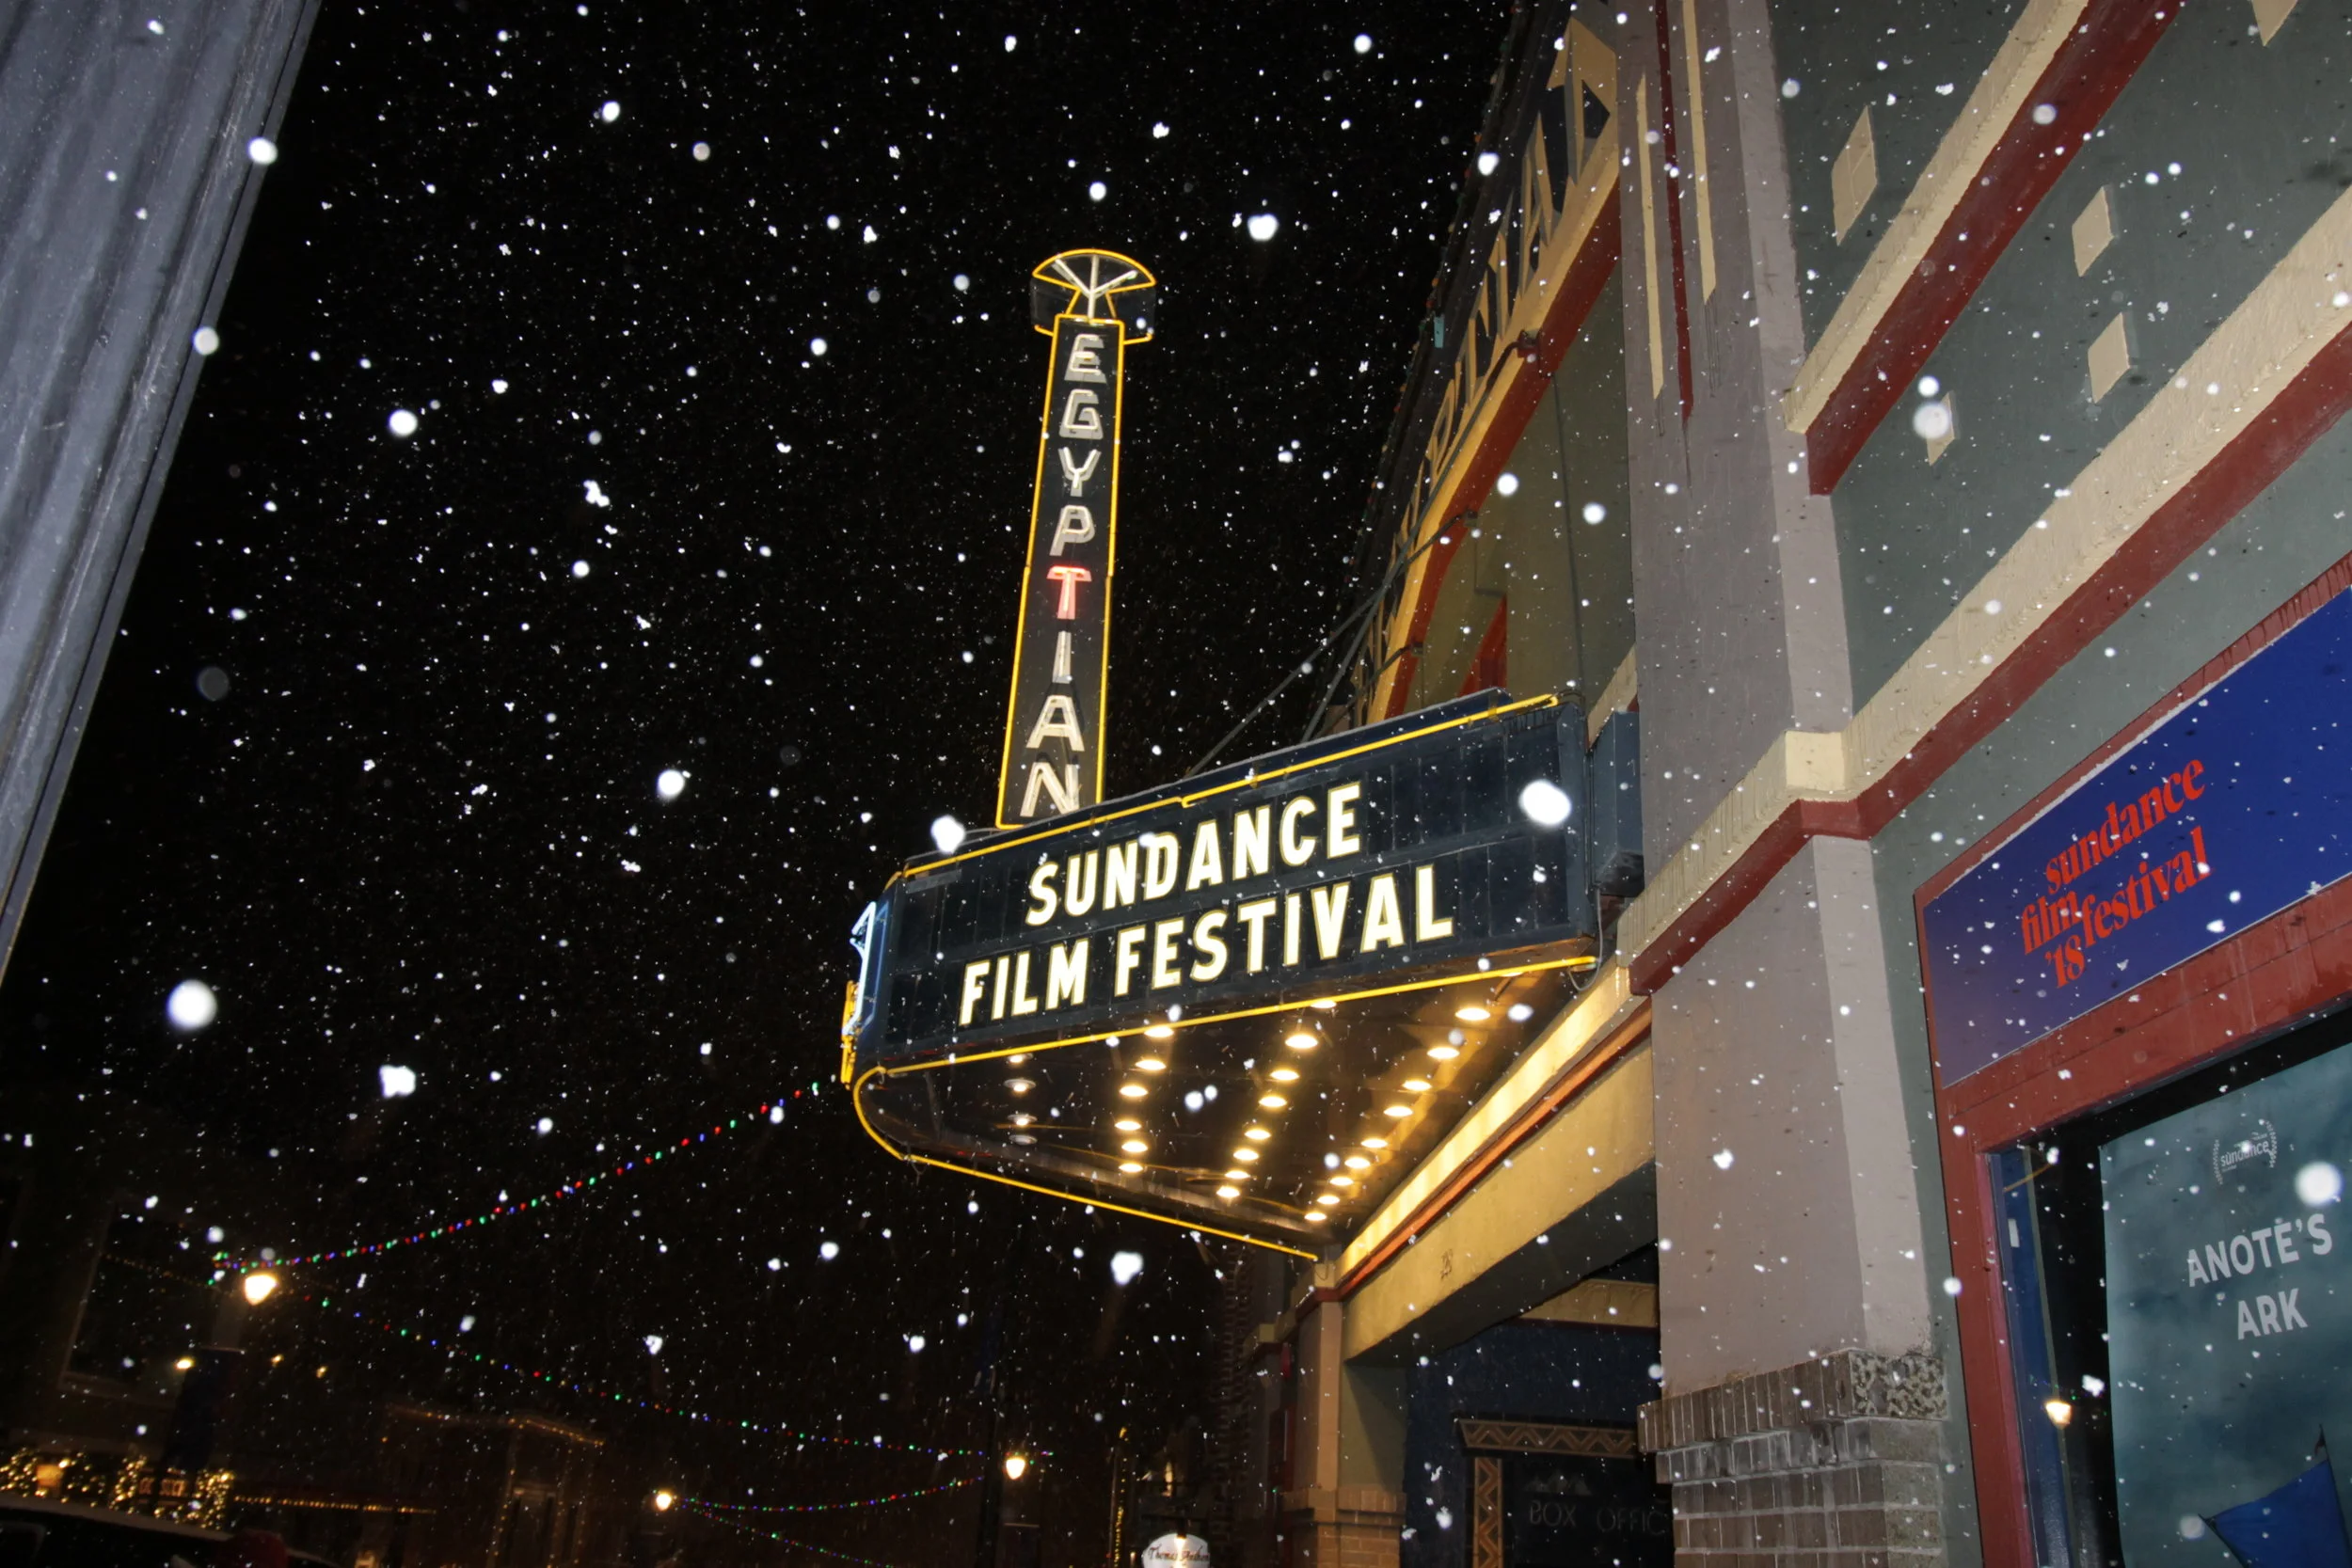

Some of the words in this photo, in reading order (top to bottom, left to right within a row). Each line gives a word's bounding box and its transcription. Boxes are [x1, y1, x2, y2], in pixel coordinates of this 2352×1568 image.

[1020, 332, 1107, 817] EGYPTIAN
[1025, 781, 1361, 926] SUNDANCE
[2021, 890, 2080, 955] film
[2081, 826, 2213, 948] festival
[2045, 759, 2206, 895] sundance
[959, 938, 1091, 1027] FILM
[1114, 863, 1455, 997] FESTIVAL
[2187, 1213, 2333, 1287] ANOTE'S
[2237, 1288, 2308, 1340] ARK
[1529, 1499, 1577, 1528] BOX
[1597, 1507, 1671, 1536] OFFIC
